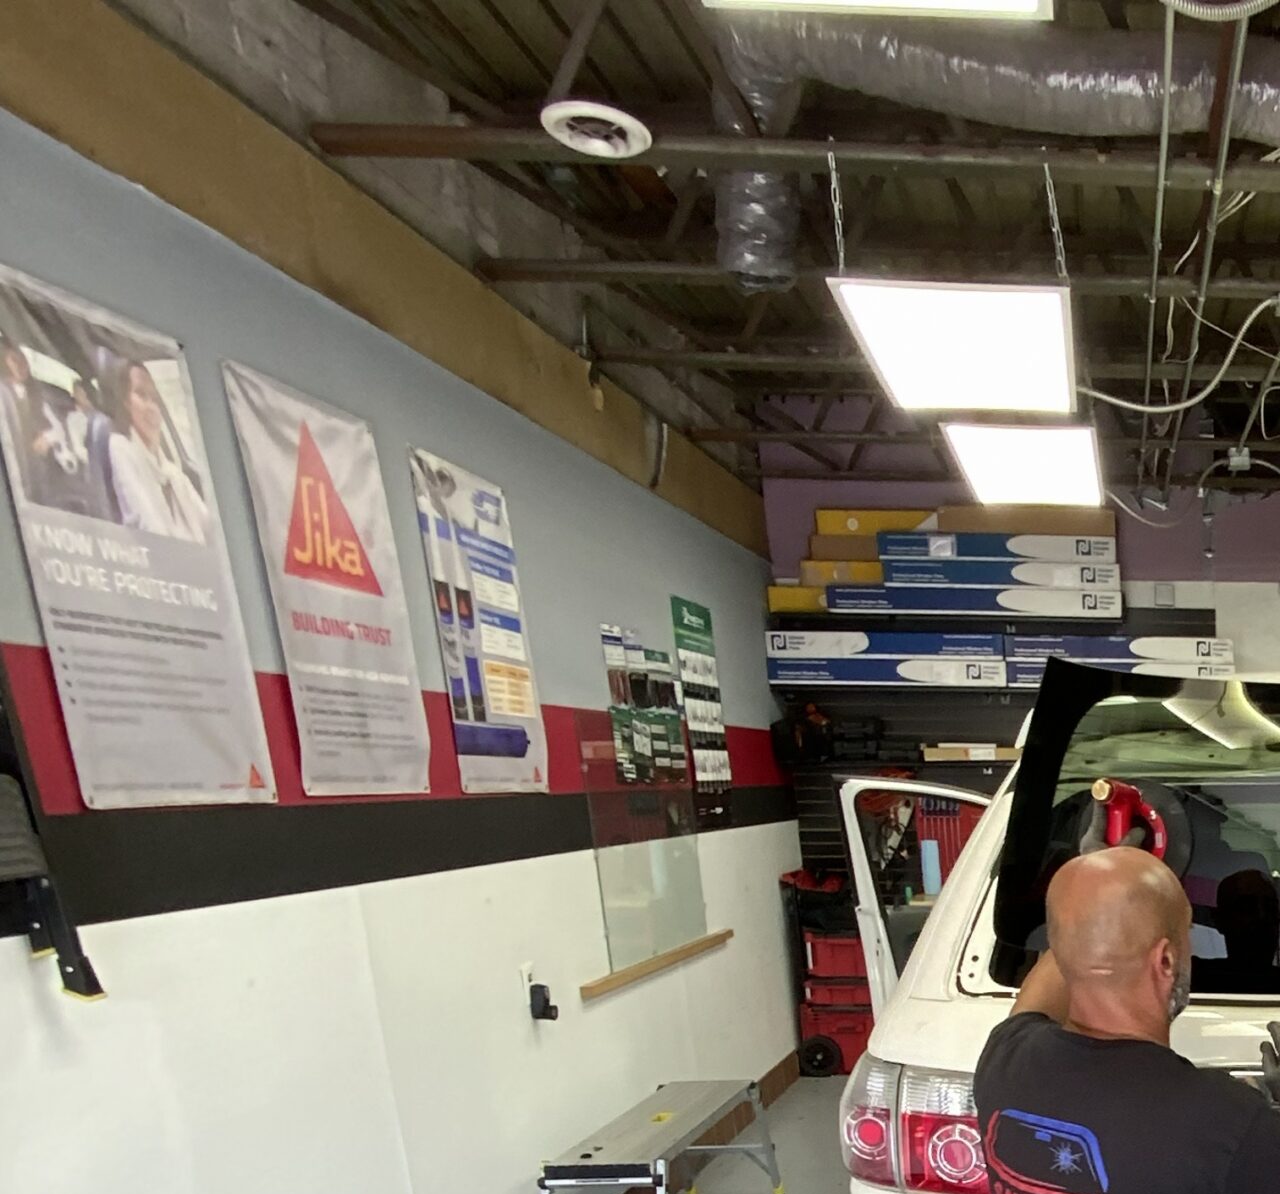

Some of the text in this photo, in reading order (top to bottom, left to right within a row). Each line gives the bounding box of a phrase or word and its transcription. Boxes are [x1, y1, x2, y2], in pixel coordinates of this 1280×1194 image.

[31, 522, 149, 568] KNOW WHAT
[293, 476, 364, 576] Sika
[41, 557, 218, 612] YOU'RE PROTECTING
[292, 611, 392, 647] BUILDING TRUST
